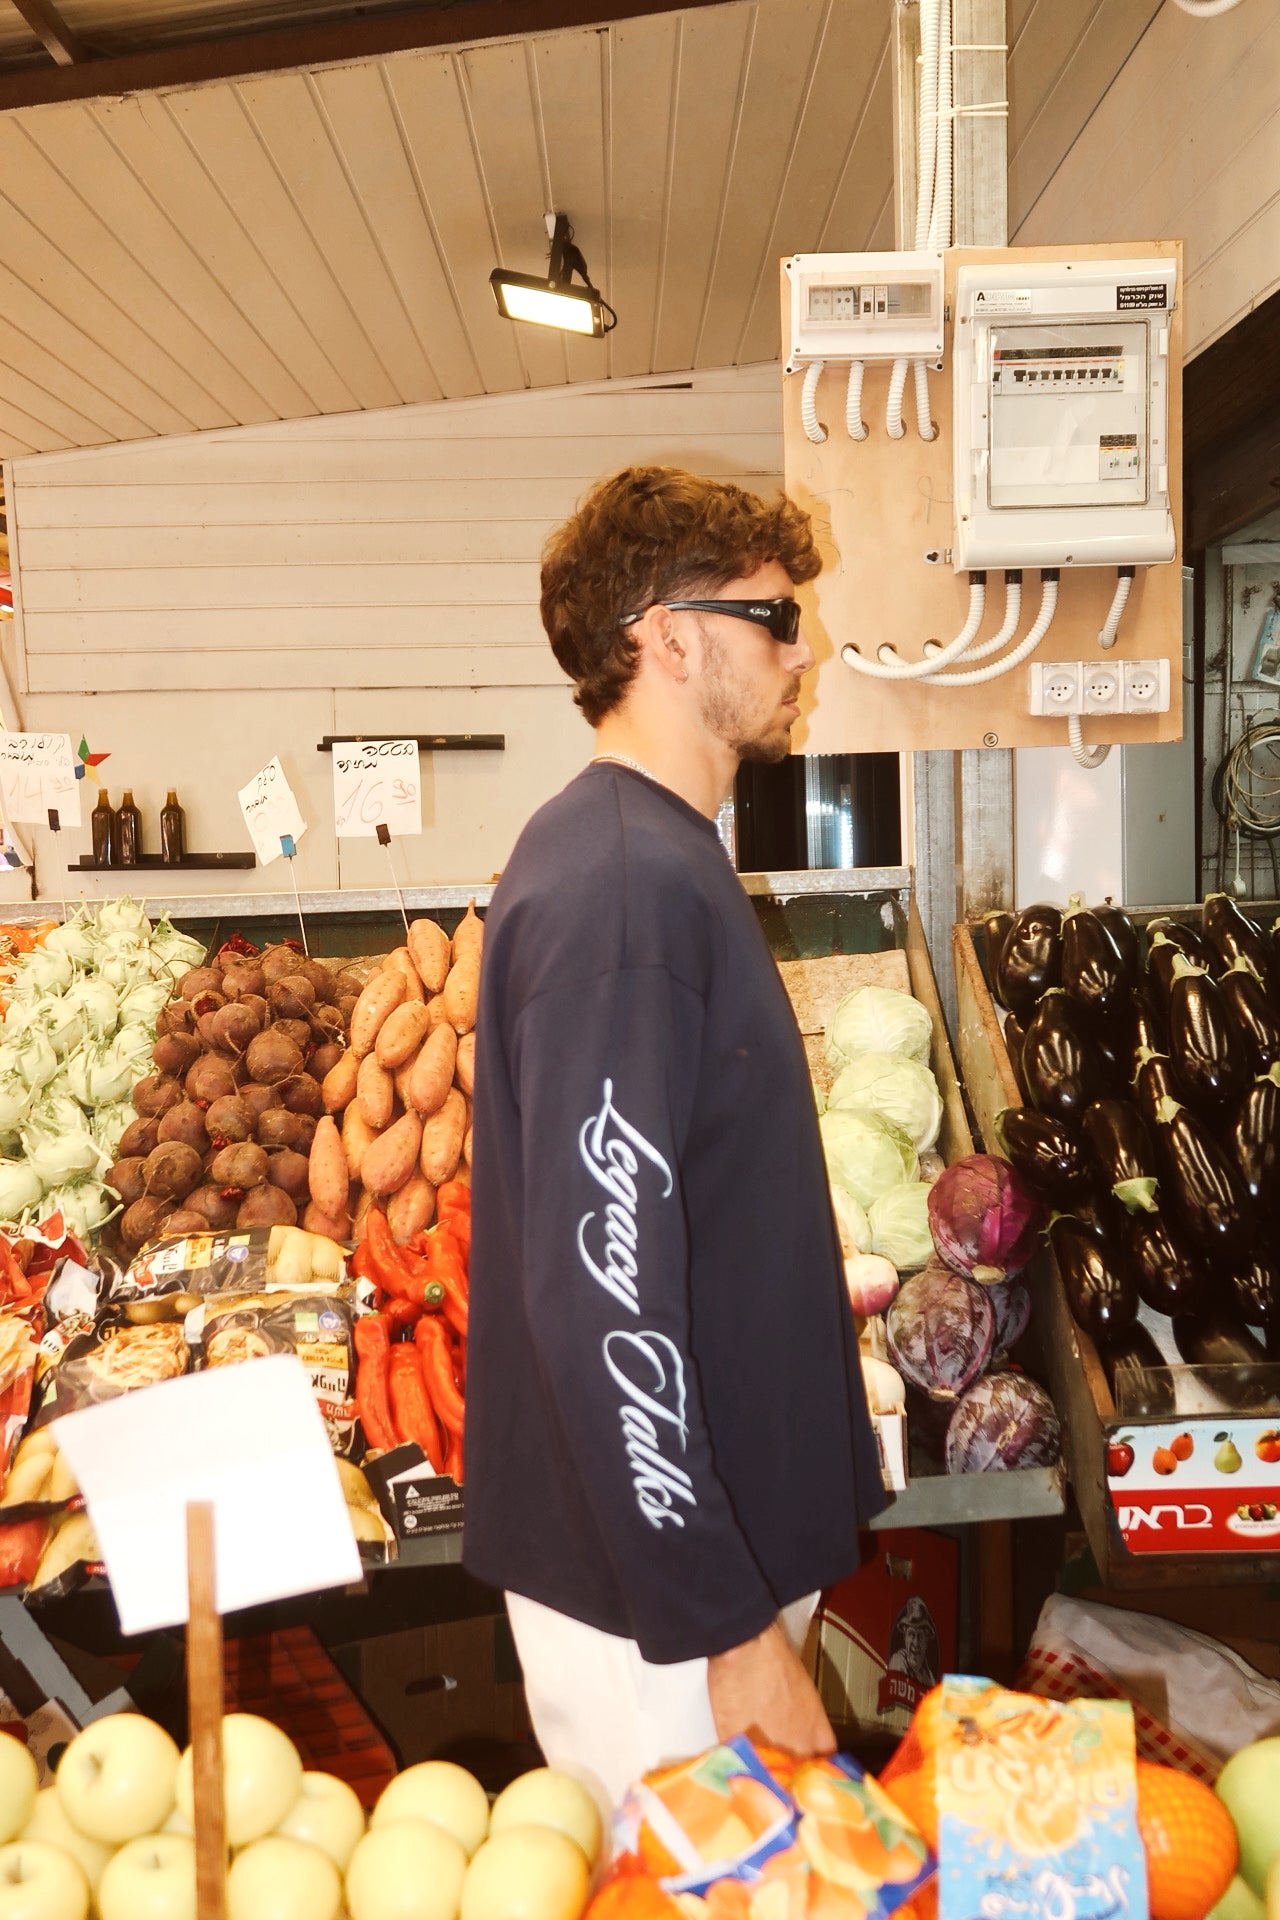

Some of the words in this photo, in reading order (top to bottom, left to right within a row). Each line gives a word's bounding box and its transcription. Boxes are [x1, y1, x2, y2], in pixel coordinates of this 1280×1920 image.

[1148, 293, 1164, 301] שוק
[362, 742, 414, 757] בטטה
[342, 779, 384, 824] 16
[578, 1077, 674, 1317] Legacy
[602, 1329, 698, 1532] Talks
[889, 1677, 916, 1702] משה
